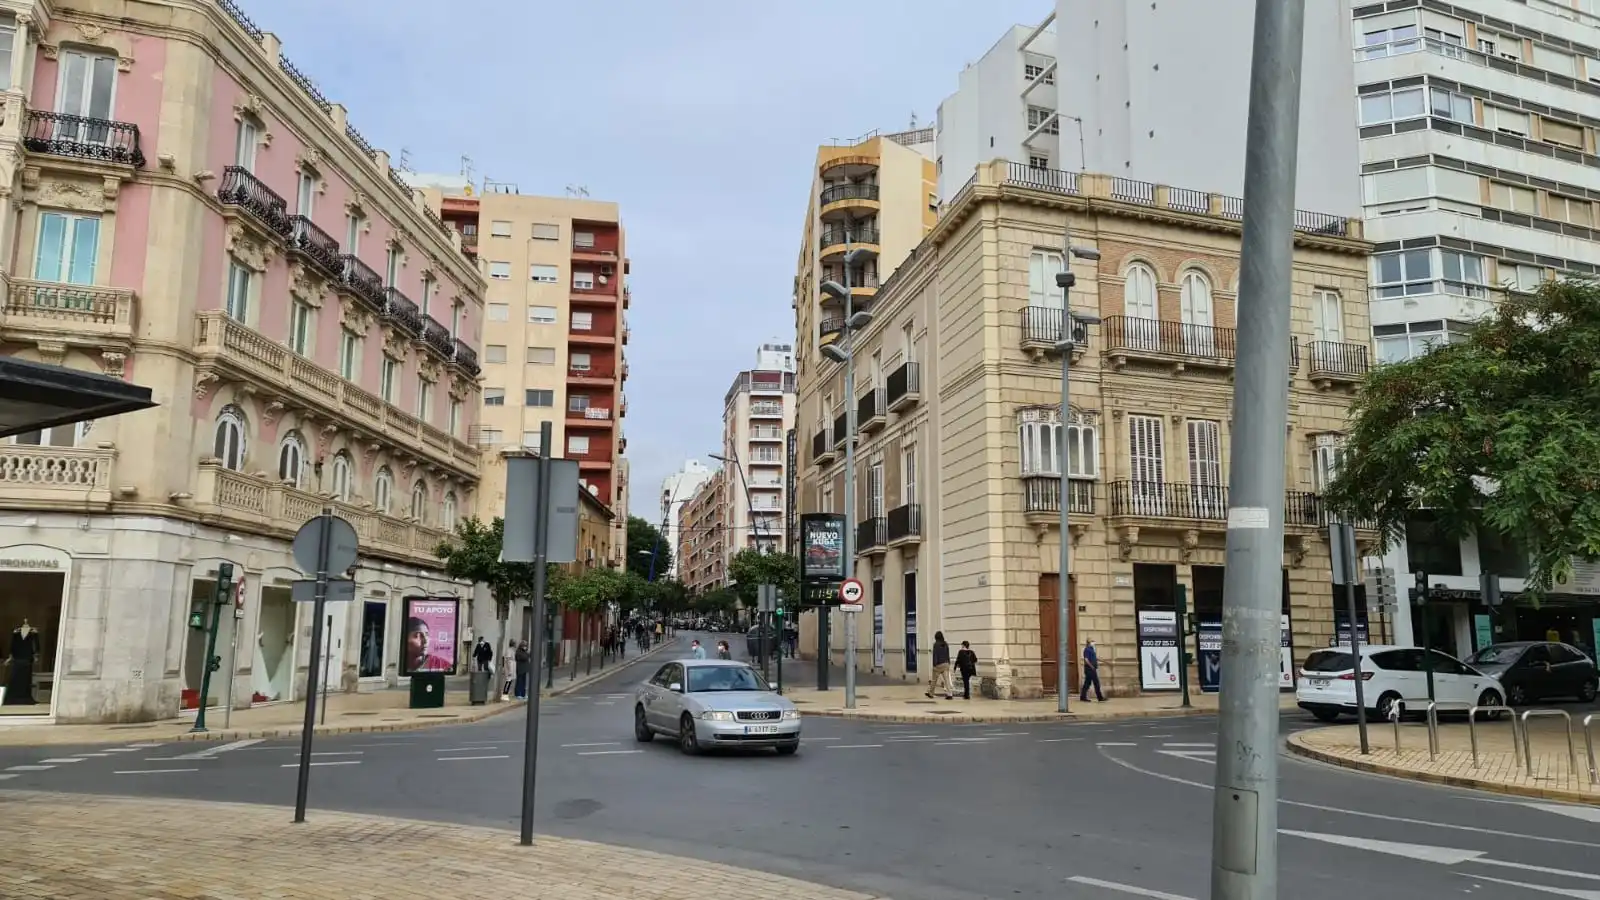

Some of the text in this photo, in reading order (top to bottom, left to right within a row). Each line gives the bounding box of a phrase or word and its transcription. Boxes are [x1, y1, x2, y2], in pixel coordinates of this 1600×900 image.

[810, 531, 838, 539] NUEVO
[0, 559, 59, 569] PRONOVIAS
[426, 606, 453, 614] APOYO
